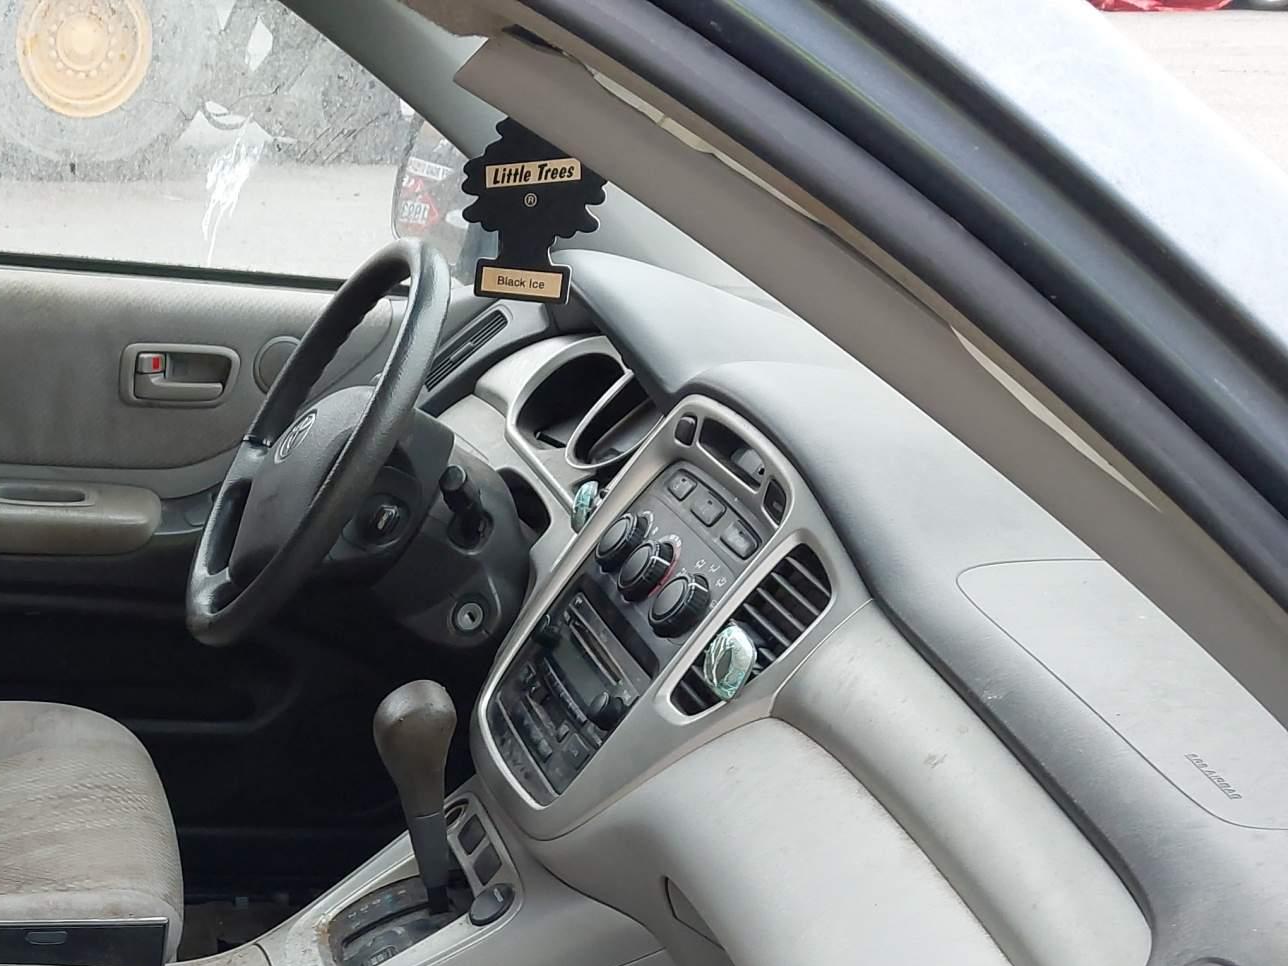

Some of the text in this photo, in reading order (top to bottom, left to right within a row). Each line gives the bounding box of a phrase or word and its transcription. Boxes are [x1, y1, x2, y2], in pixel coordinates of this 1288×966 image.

[493, 163, 575, 185] Little Trees
[497, 275, 545, 289] Black Ice
